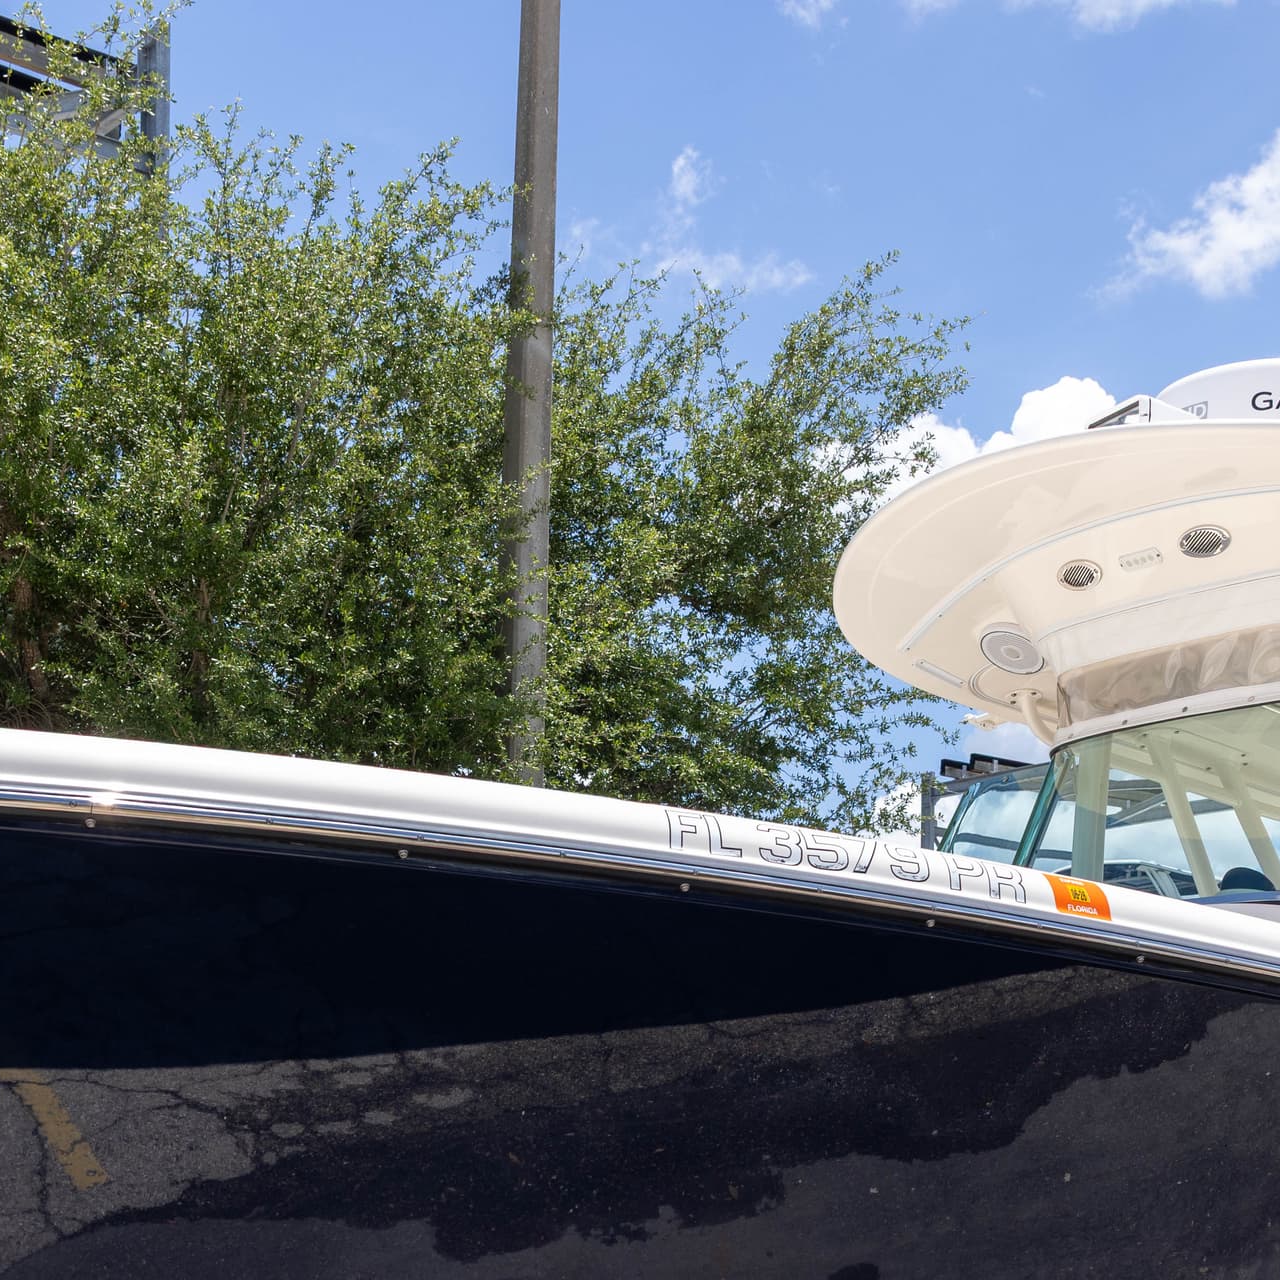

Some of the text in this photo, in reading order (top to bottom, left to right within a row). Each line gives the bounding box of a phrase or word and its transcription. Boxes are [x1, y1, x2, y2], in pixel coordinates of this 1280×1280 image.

[665, 809, 1027, 904] FL 3579 PR
[1067, 903, 1099, 916] FLORIDA
